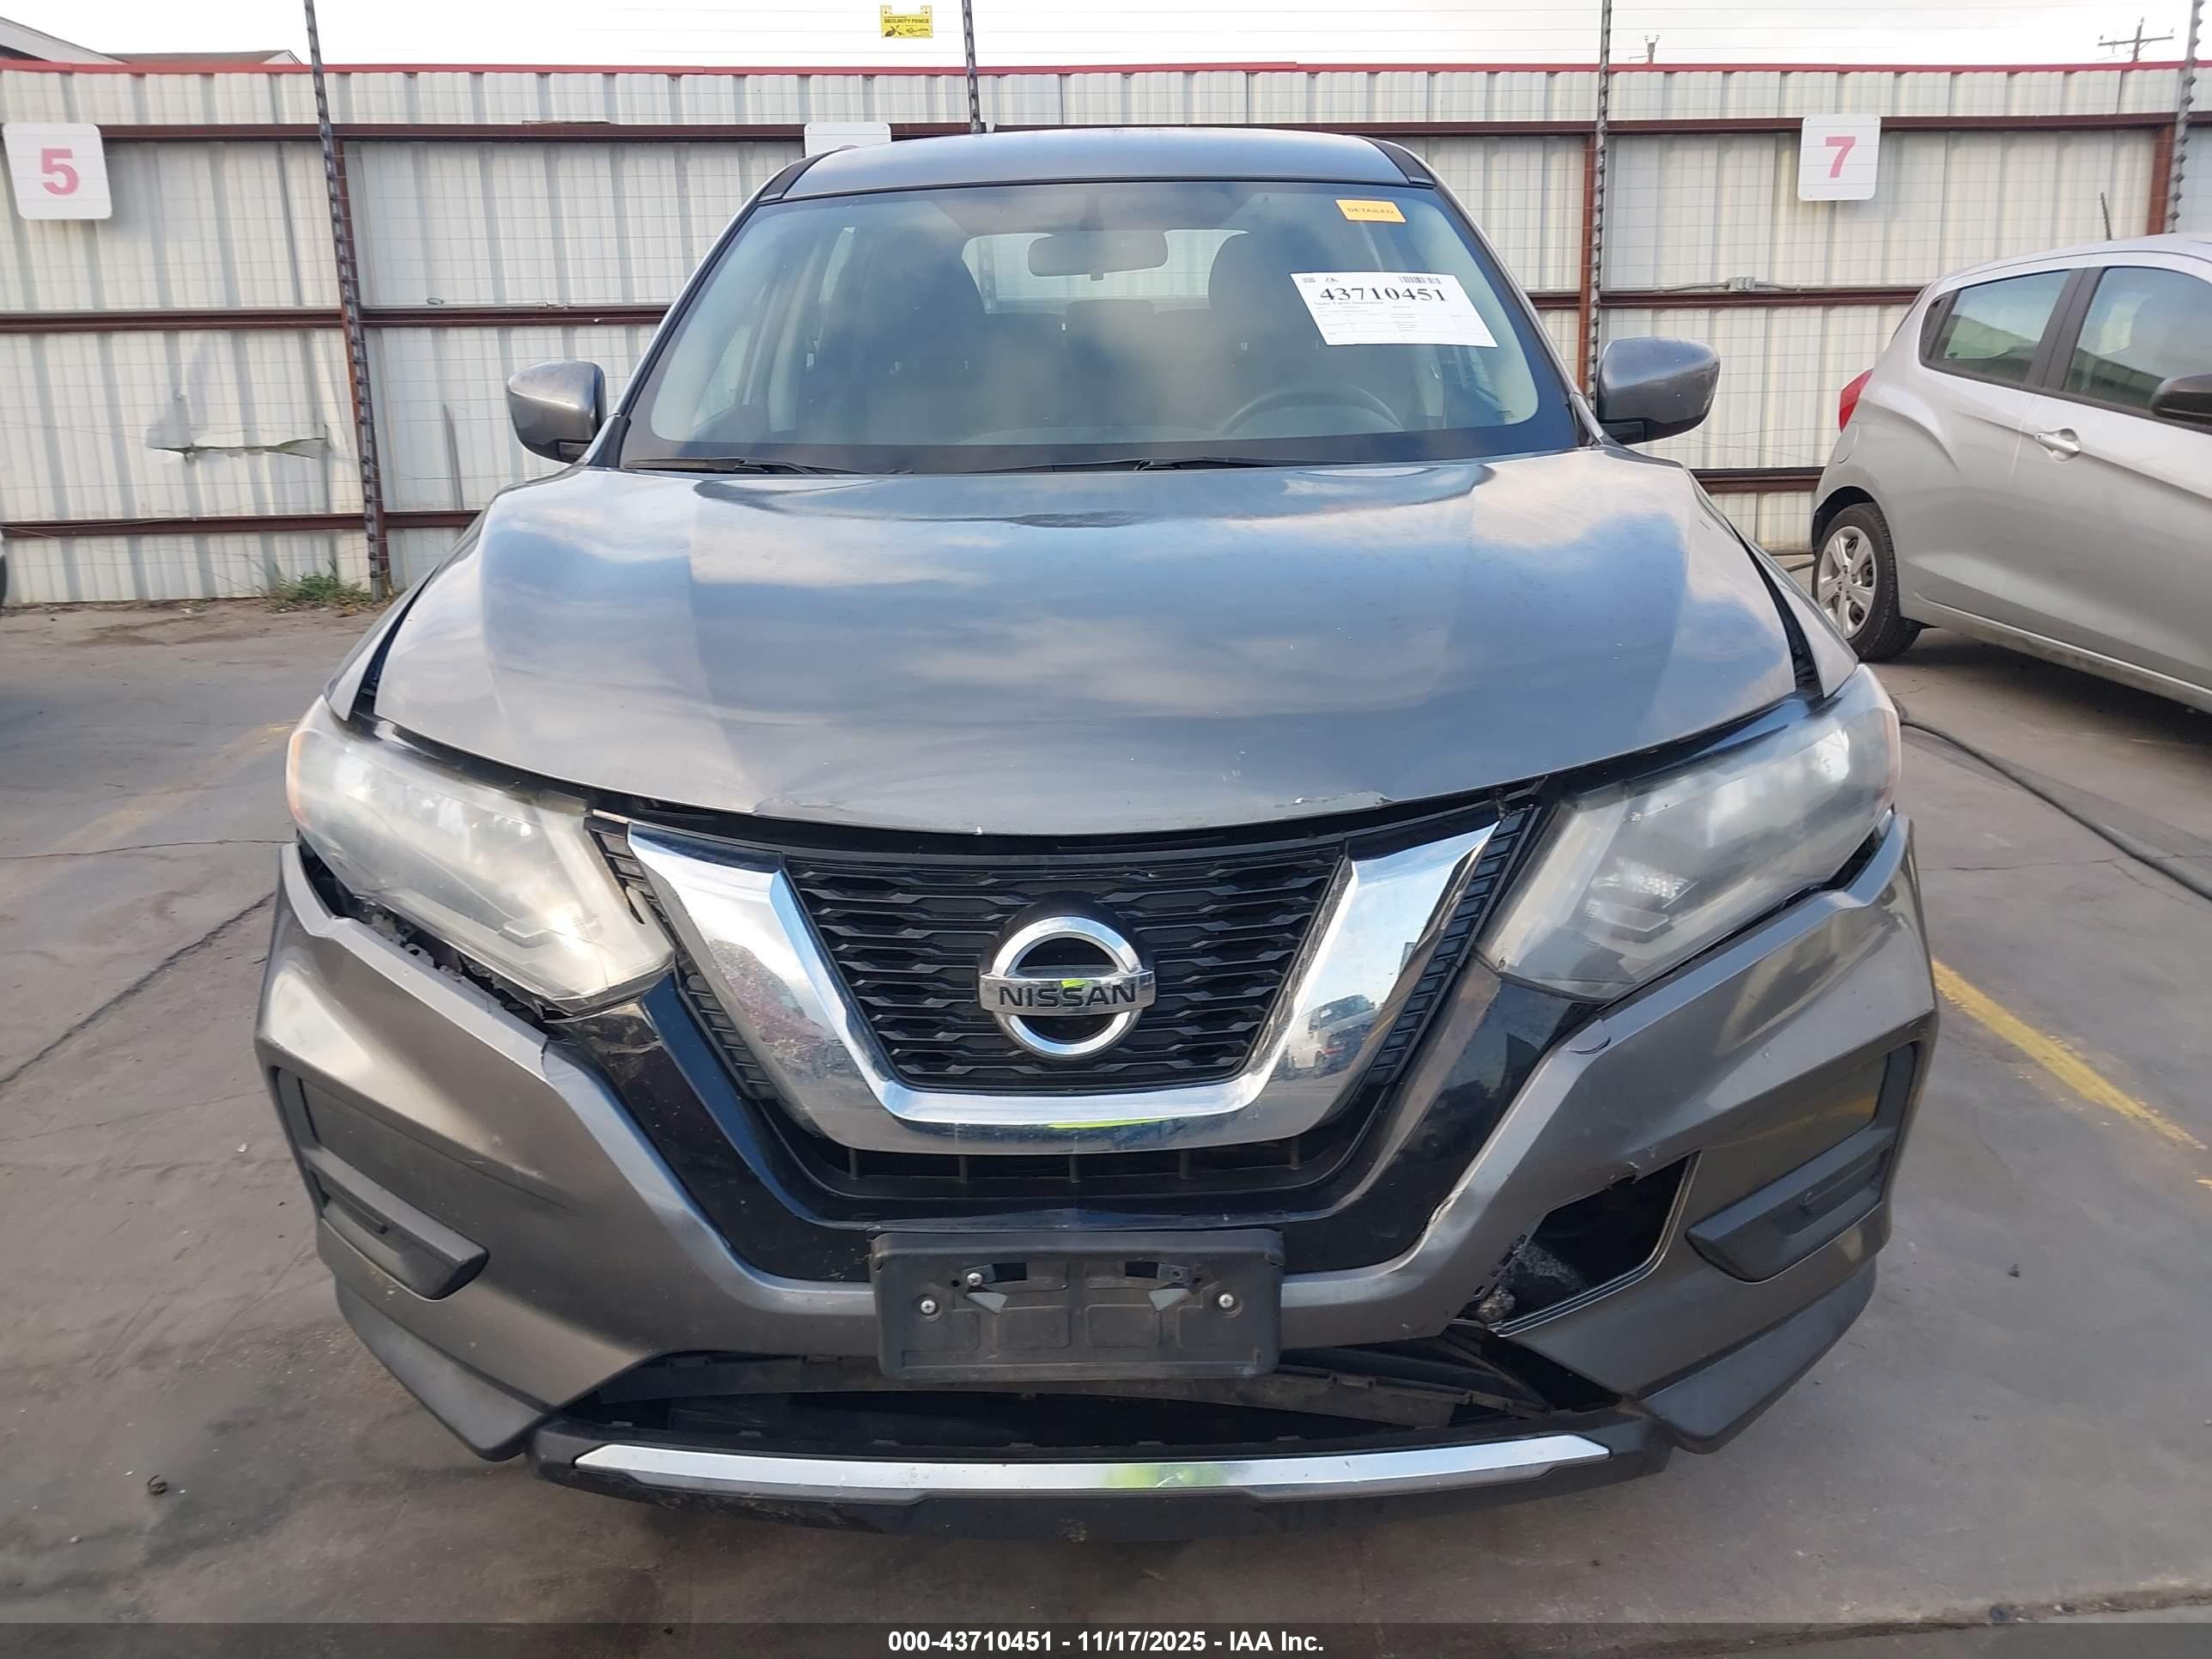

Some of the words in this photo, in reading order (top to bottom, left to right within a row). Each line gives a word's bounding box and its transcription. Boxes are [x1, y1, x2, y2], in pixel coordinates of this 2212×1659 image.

[40, 149, 78, 196] 5
[1826, 137, 1856, 178] 7
[1320, 287, 1448, 301] 43710451
[999, 982, 1137, 1008] NISSAN
